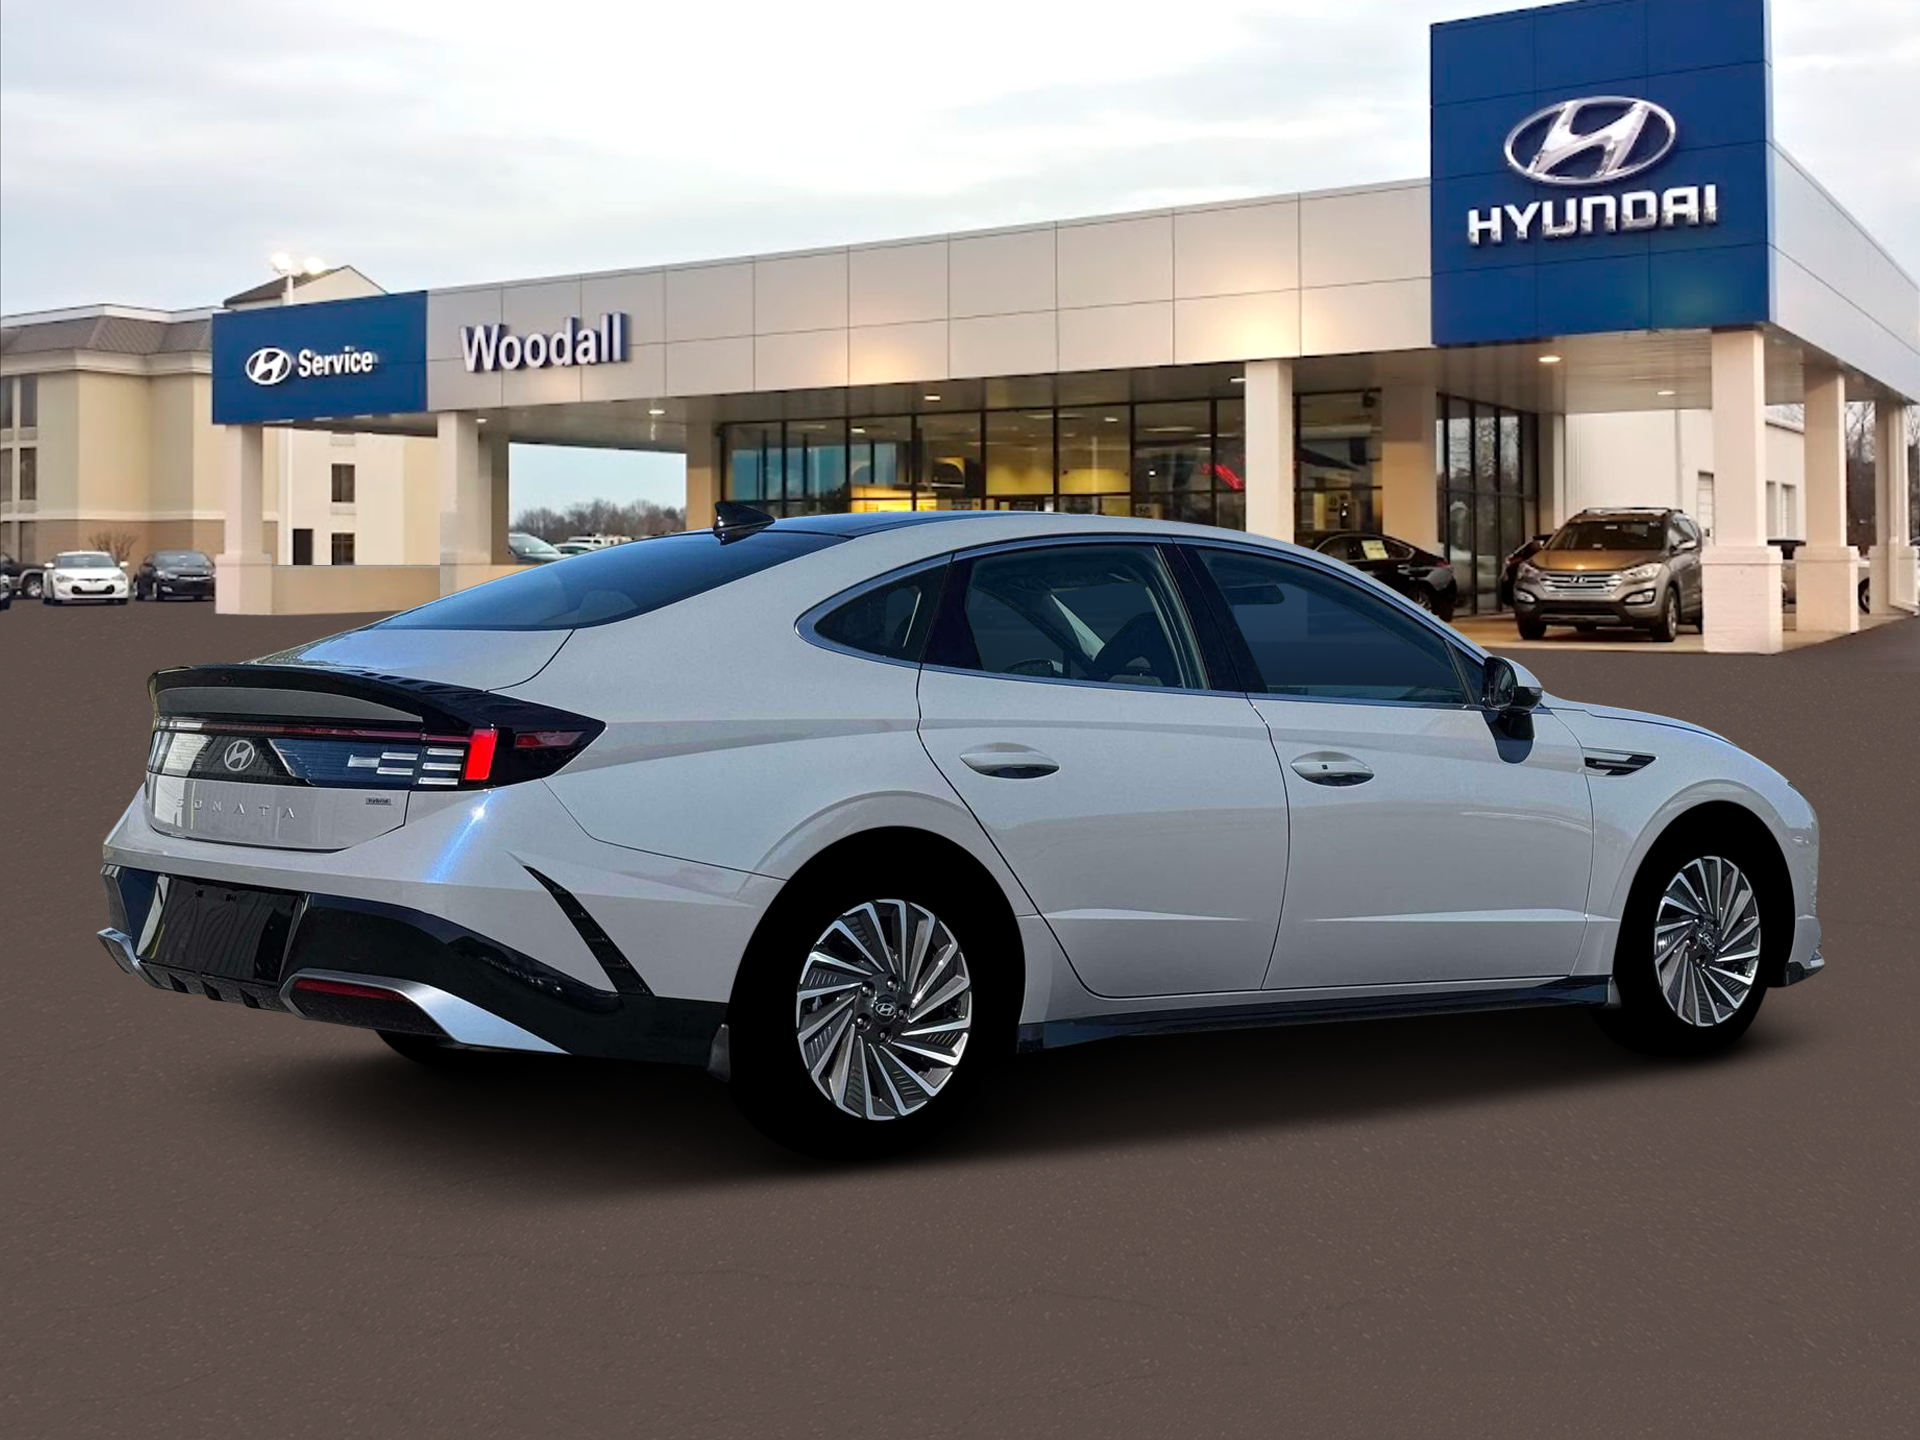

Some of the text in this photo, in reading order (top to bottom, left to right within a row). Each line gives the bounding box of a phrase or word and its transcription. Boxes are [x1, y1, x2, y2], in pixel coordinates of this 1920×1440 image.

[1468, 184, 1717, 245] HYUNDAI
[298, 345, 374, 378] Service
[460, 312, 630, 373] Woodall
